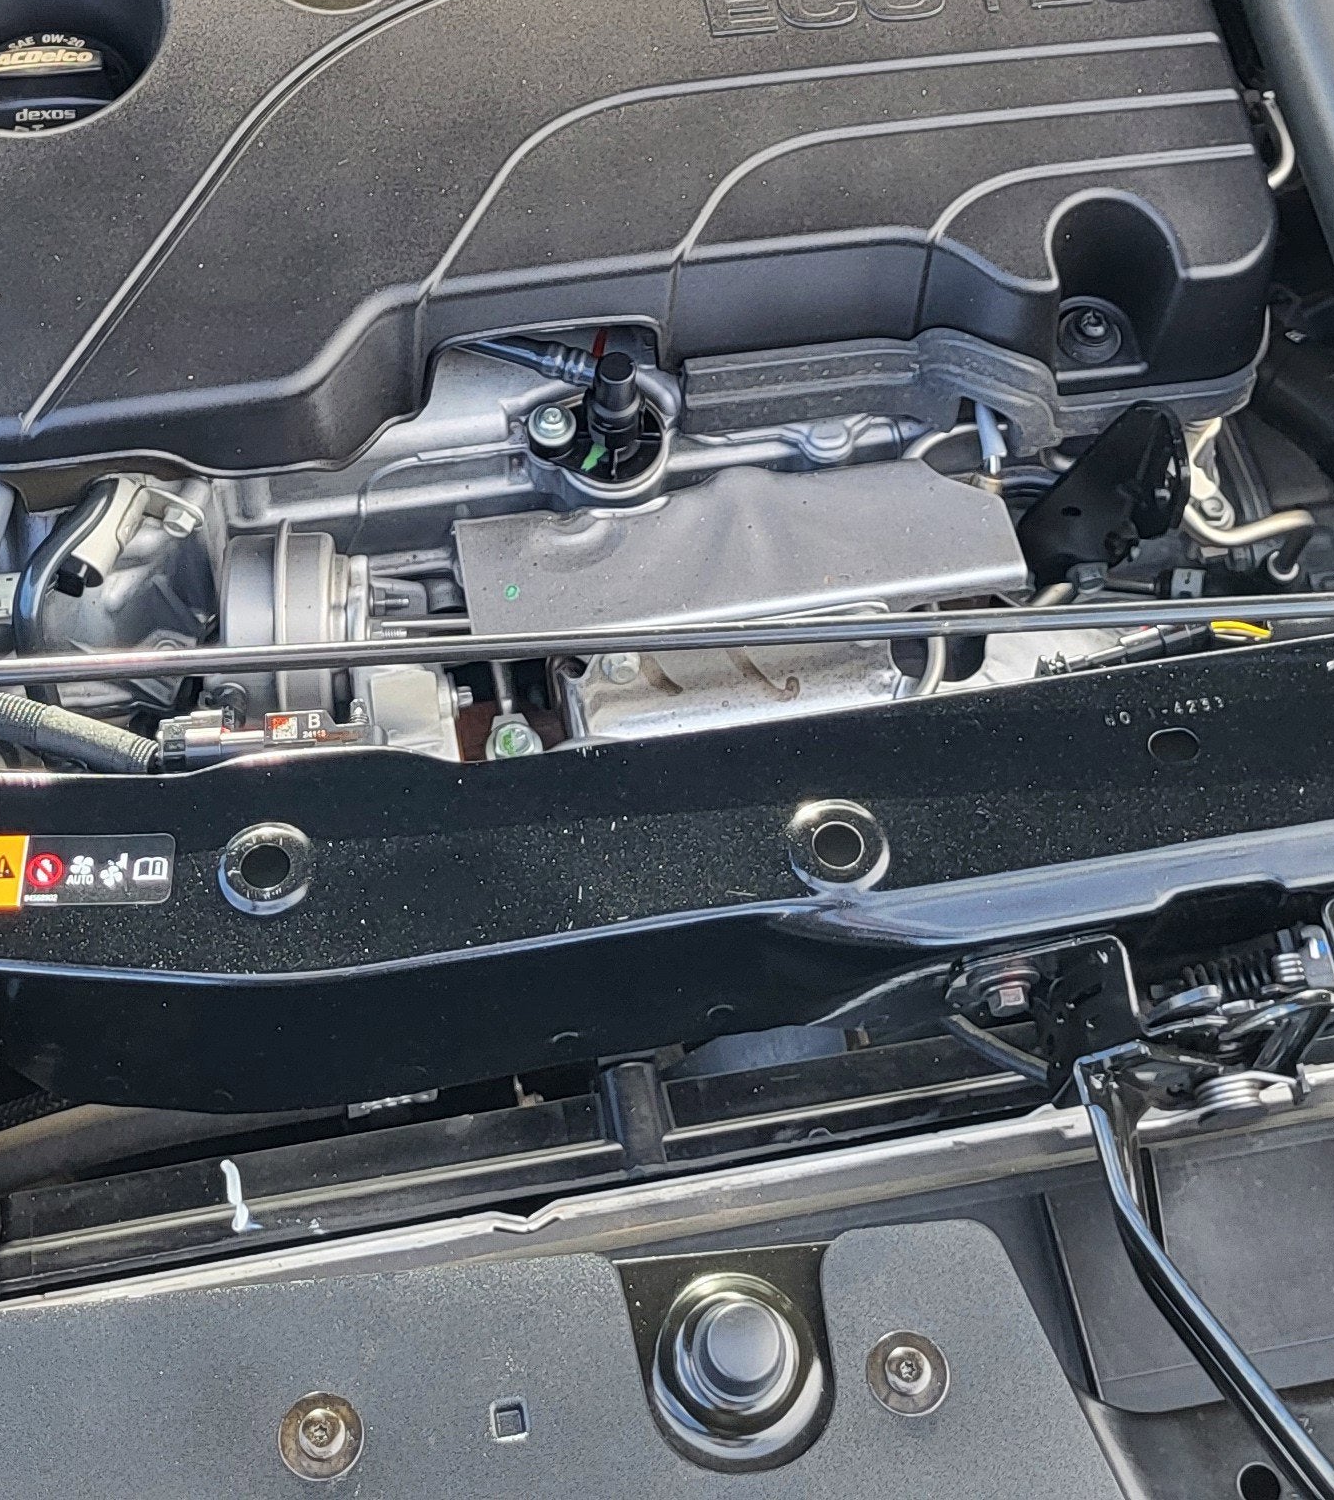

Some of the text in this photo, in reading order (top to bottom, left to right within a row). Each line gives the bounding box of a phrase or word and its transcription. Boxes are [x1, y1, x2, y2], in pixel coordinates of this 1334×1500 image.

[8, 33, 86, 50] SAE 0W-20
[14, 108, 76, 122] dexos
[308, 713, 321, 729] B
[65, 874, 94, 886] AUTO
